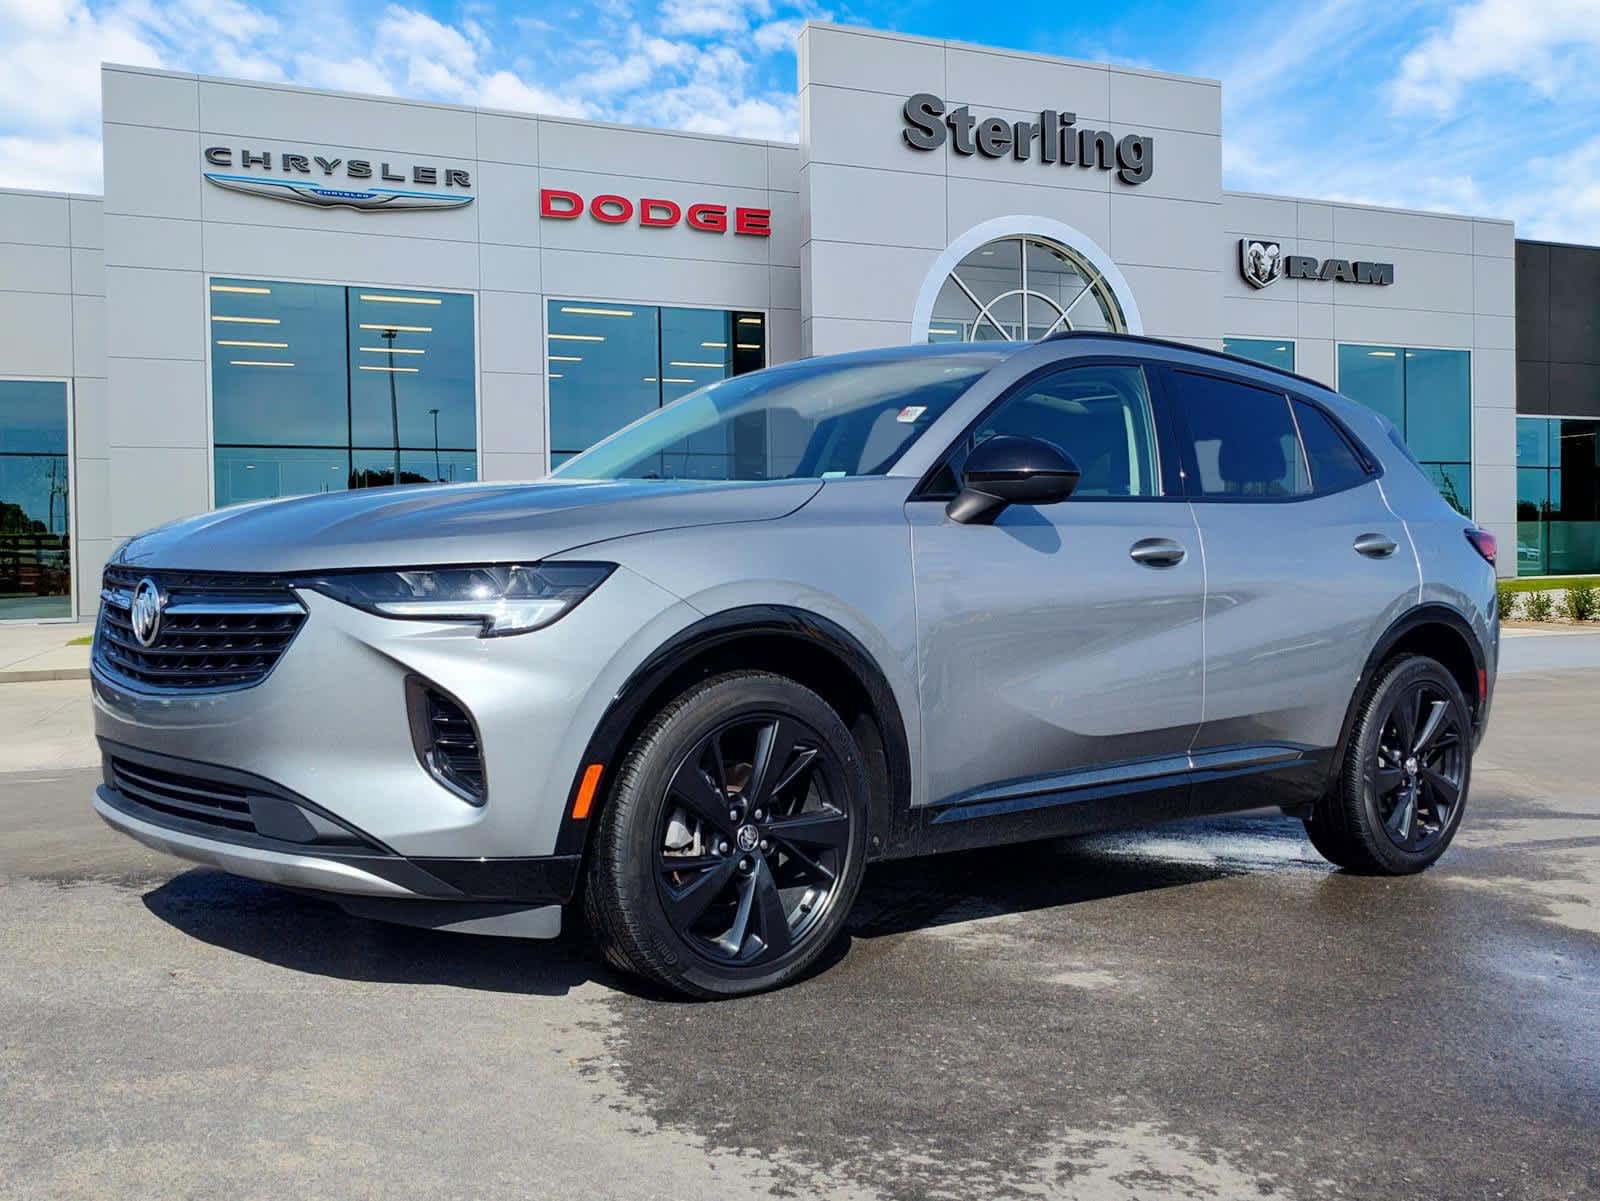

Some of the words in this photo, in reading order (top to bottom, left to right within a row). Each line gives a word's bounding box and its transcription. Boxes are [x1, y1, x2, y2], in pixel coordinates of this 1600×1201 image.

[903, 93, 1154, 185] Sterling
[204, 146, 472, 187] CHRYSLER
[539, 188, 772, 237] DODGE
[1285, 255, 1394, 285] RAM
